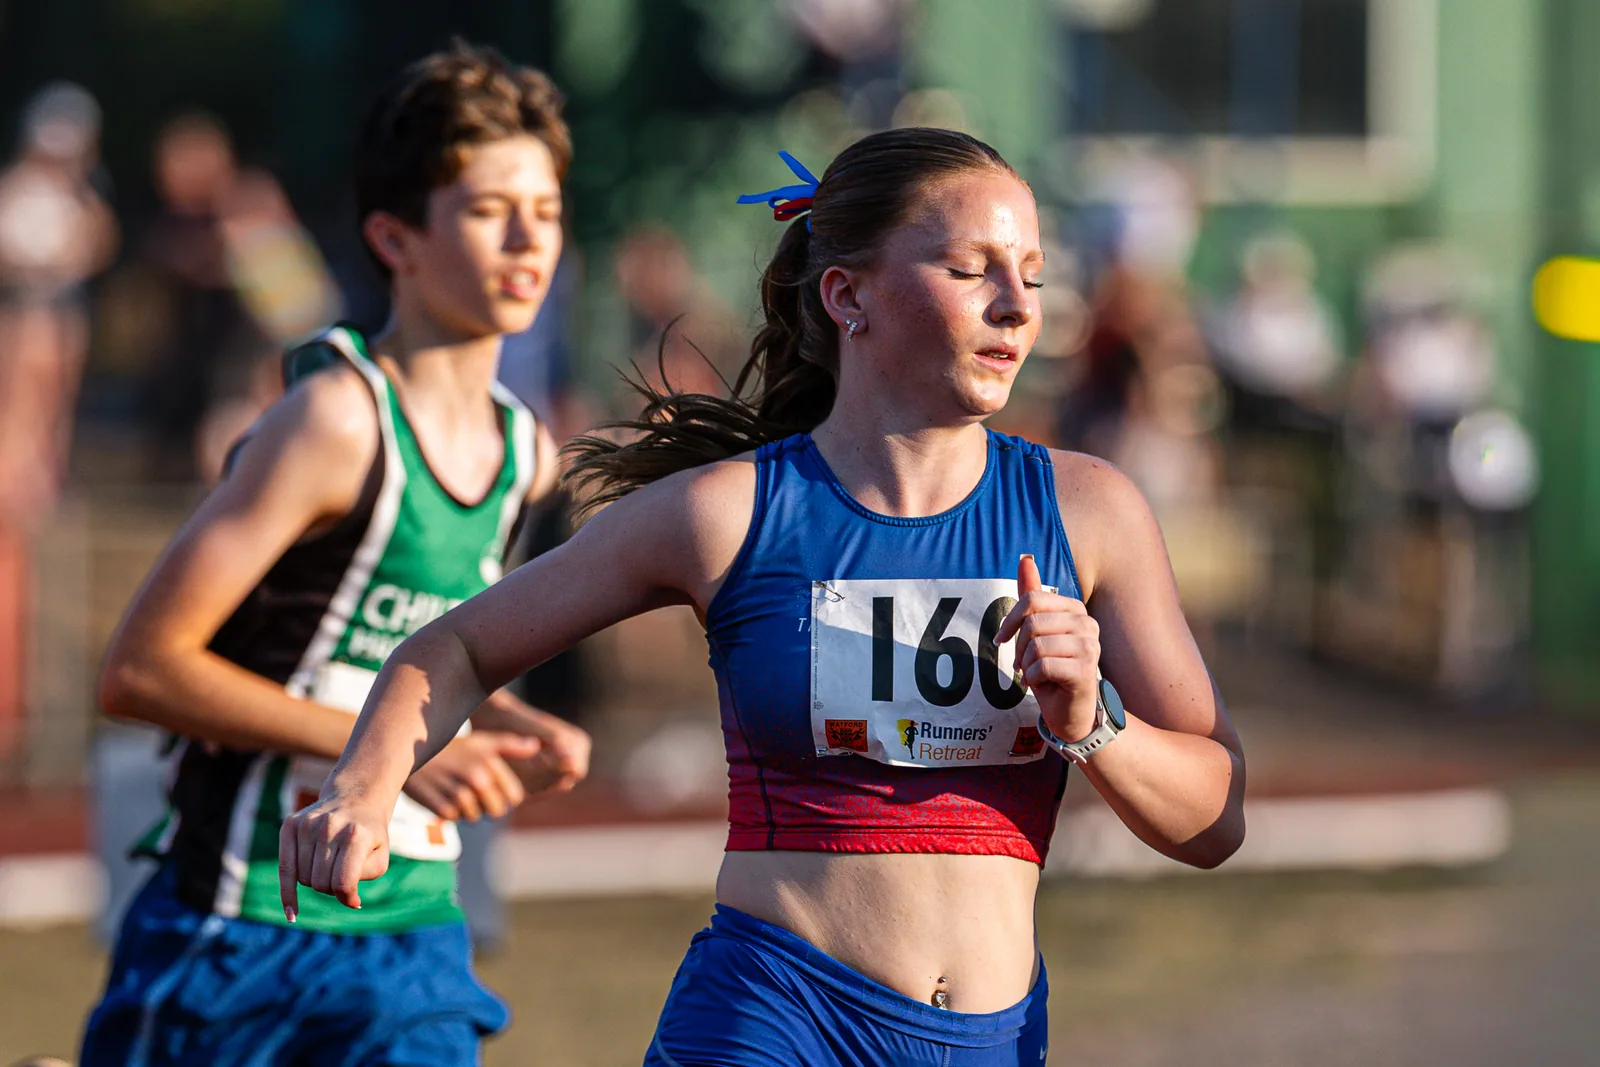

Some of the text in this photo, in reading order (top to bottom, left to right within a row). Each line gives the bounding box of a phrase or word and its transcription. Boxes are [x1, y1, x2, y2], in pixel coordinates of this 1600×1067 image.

[871, 596, 1029, 710] 160
[920, 721, 993, 741] Runners'
[919, 742, 984, 761] Retreat
